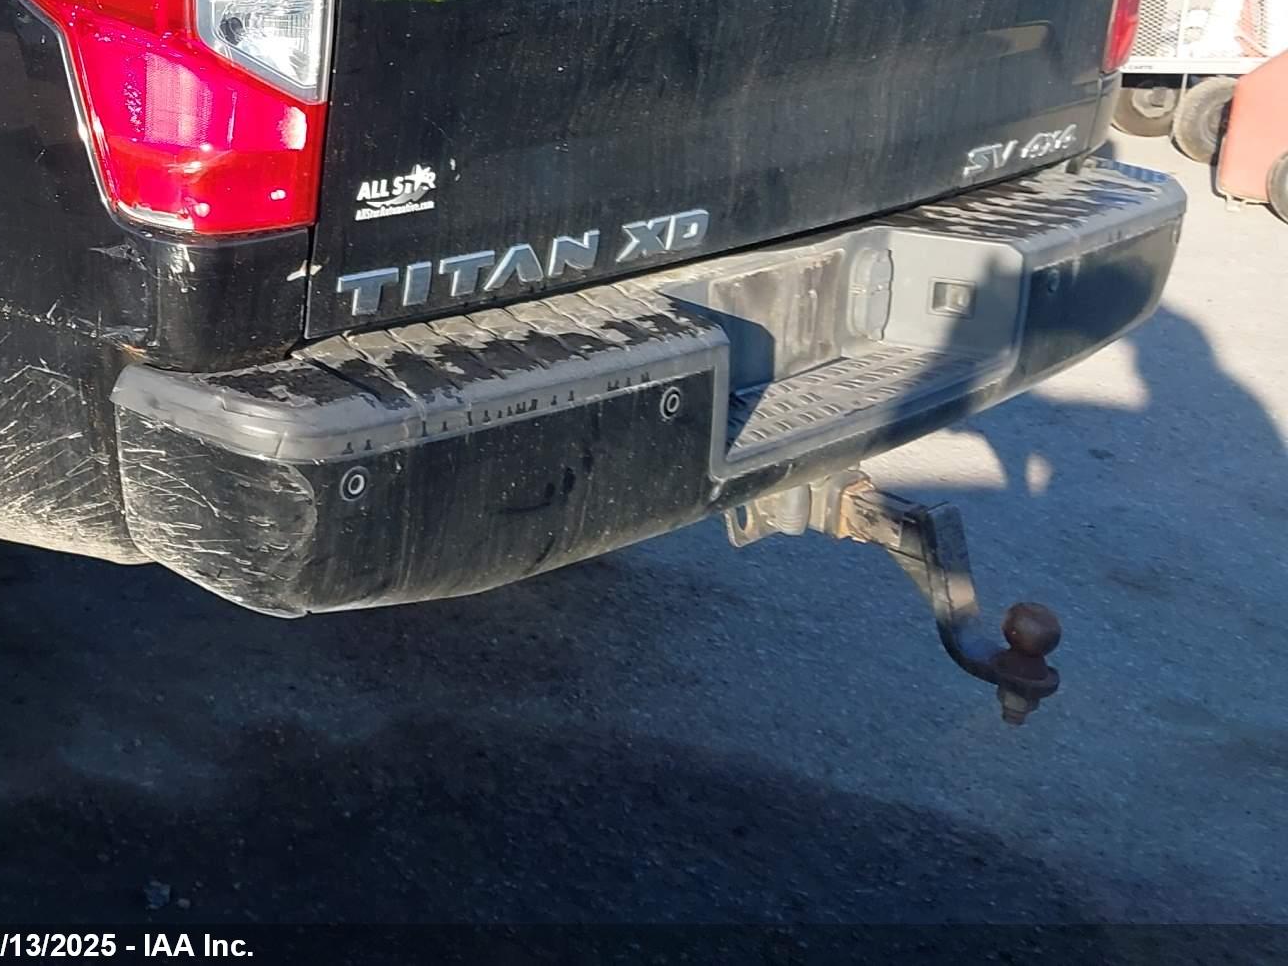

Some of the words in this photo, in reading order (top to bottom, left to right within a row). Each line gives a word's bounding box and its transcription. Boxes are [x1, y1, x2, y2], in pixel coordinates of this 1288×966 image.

[963, 139, 1019, 177] SV
[356, 179, 390, 202] ALL
[336, 229, 600, 316] TITAN
[615, 208, 710, 263] XD
